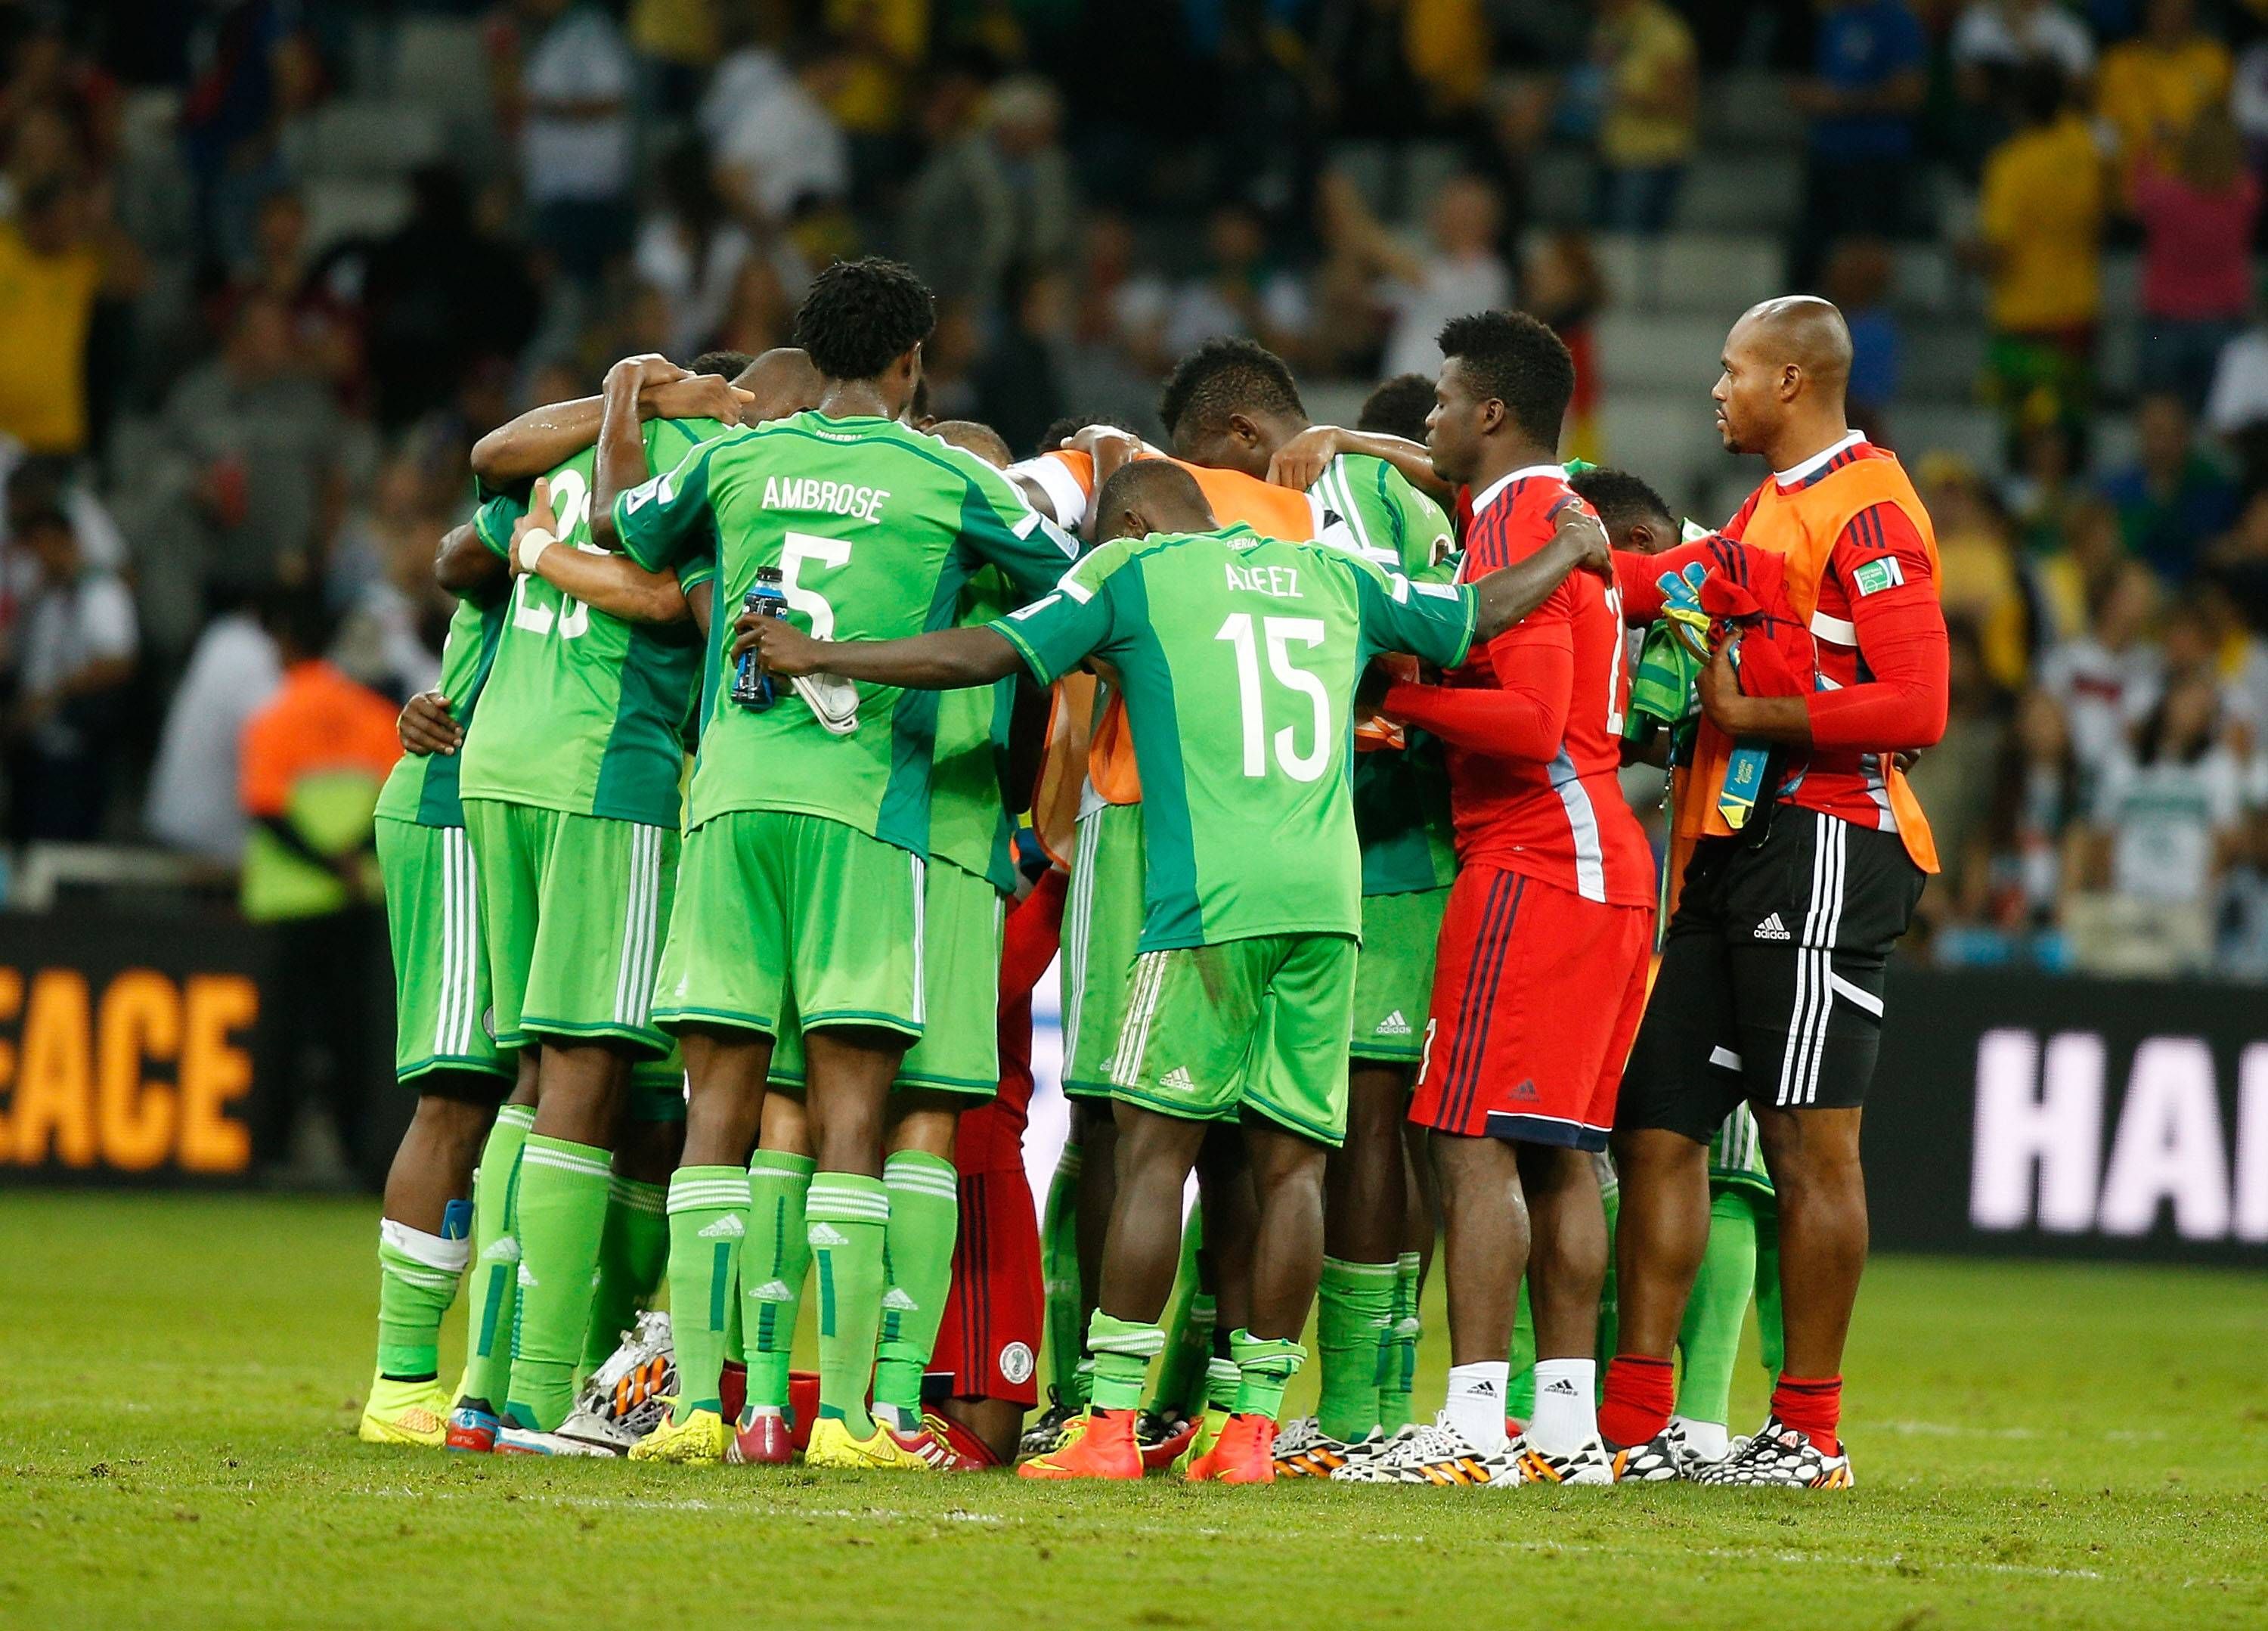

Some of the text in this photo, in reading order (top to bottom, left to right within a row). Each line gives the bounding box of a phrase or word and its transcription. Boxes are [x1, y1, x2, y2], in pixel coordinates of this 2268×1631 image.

[761, 476, 891, 524] AMBROSE
[779, 532, 852, 643] 5
[1225, 562, 1304, 597] AZEEZ
[1215, 612, 1331, 783] 15
[1754, 929, 1791, 940] adidas
[1376, 1025, 1411, 1034] adidas
[1158, 1077, 1194, 1091] adidas
[1969, 1027, 2268, 1244] HA
